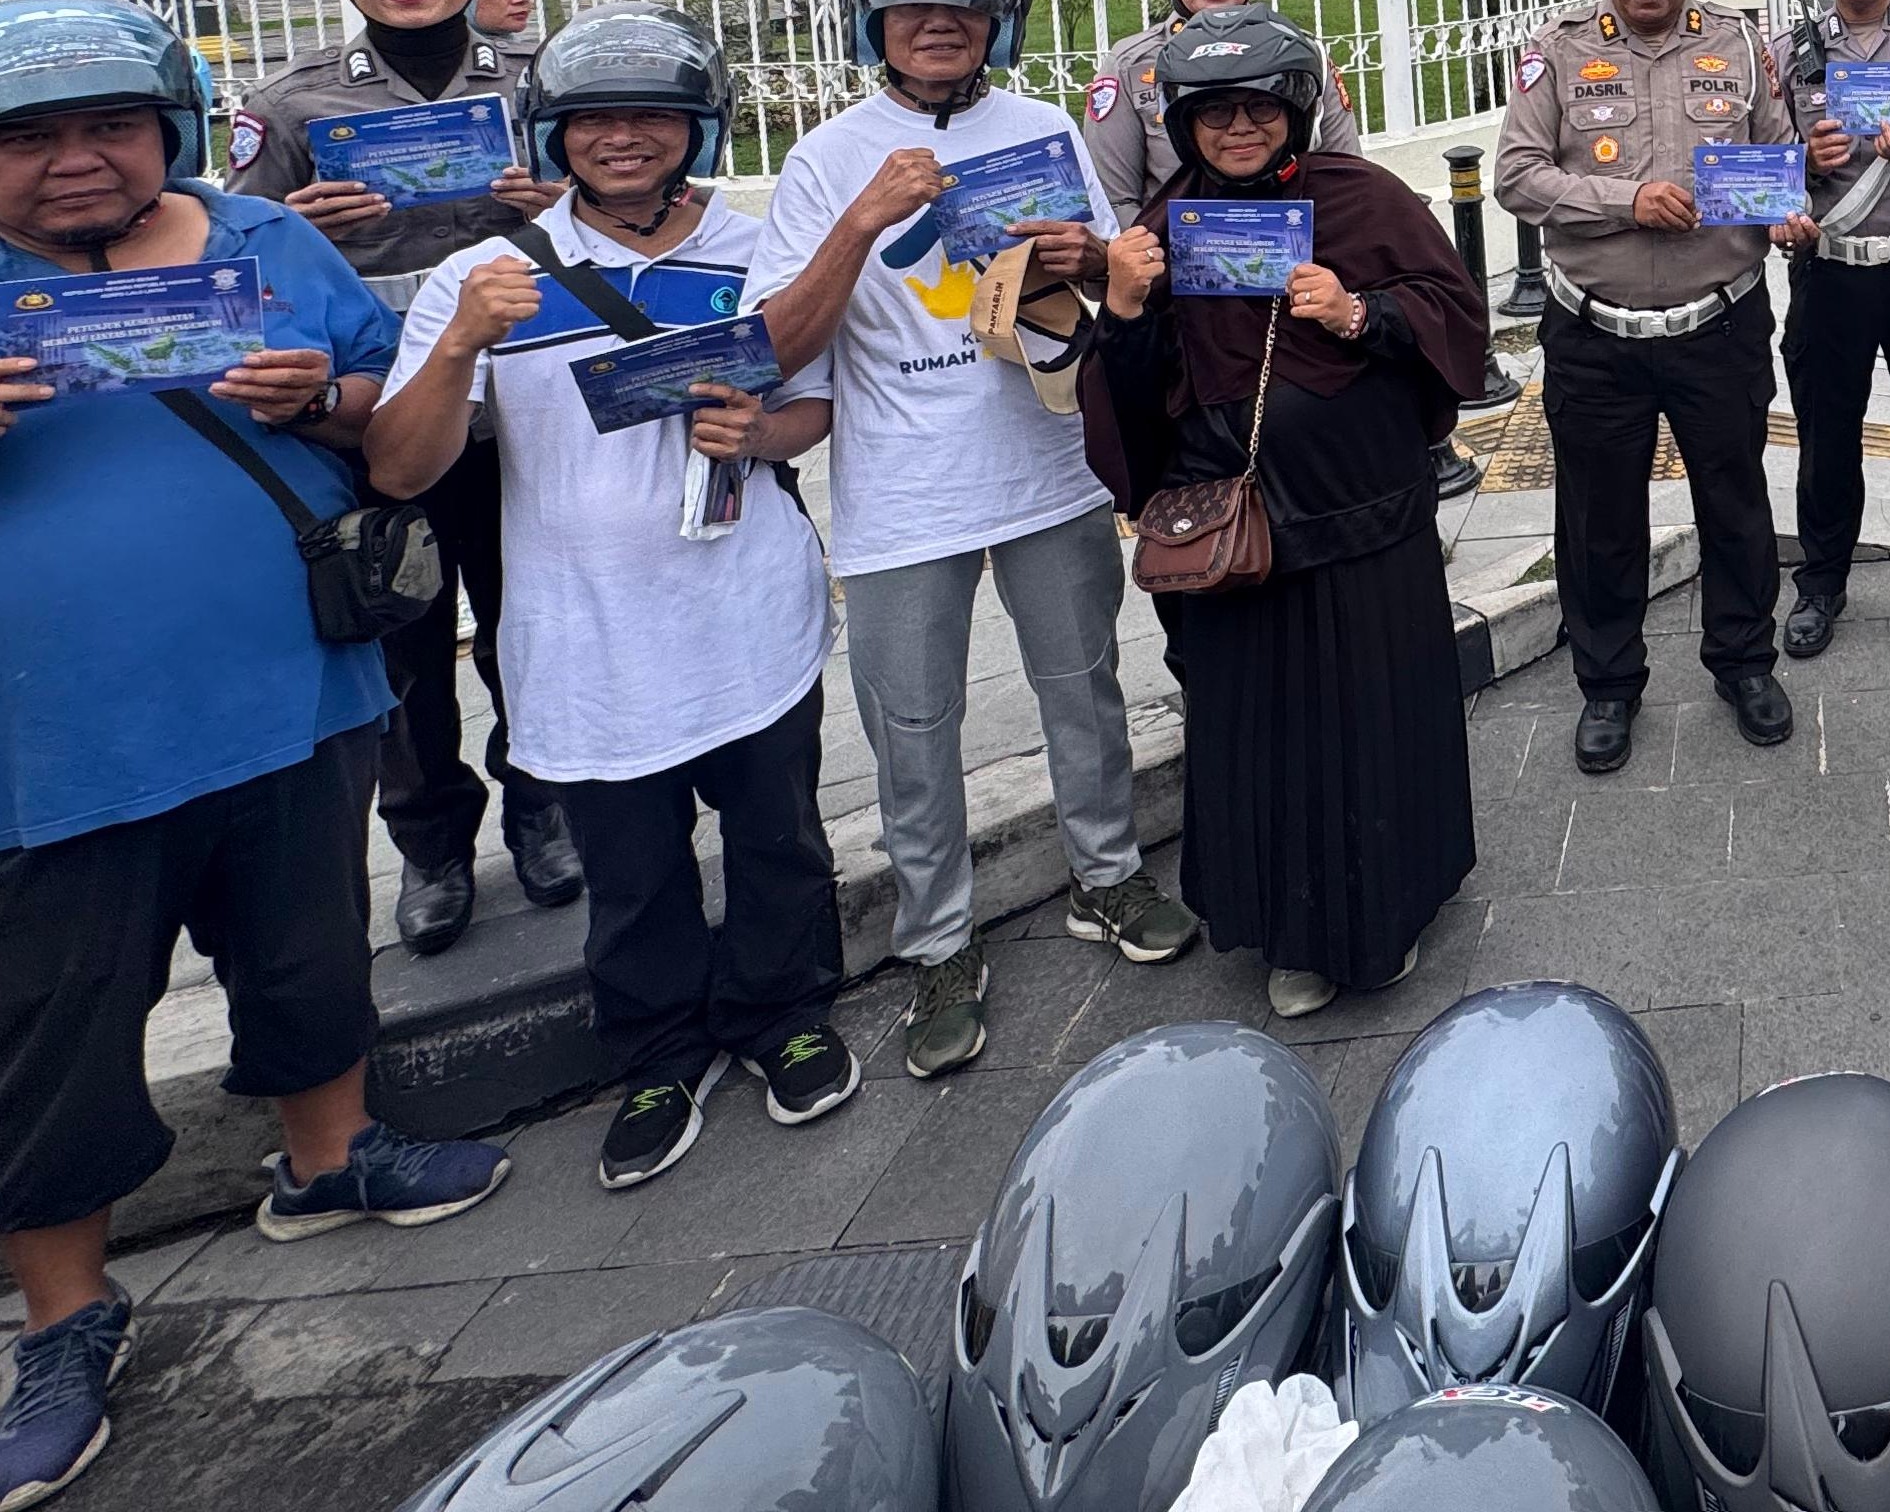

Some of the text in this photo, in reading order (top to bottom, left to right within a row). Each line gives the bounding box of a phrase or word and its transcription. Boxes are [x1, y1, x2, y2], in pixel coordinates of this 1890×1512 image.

[1575, 84, 1628, 99] DASRIL
[1690, 79, 1738, 94] POLRI
[900, 349, 976, 374] RUMAH
